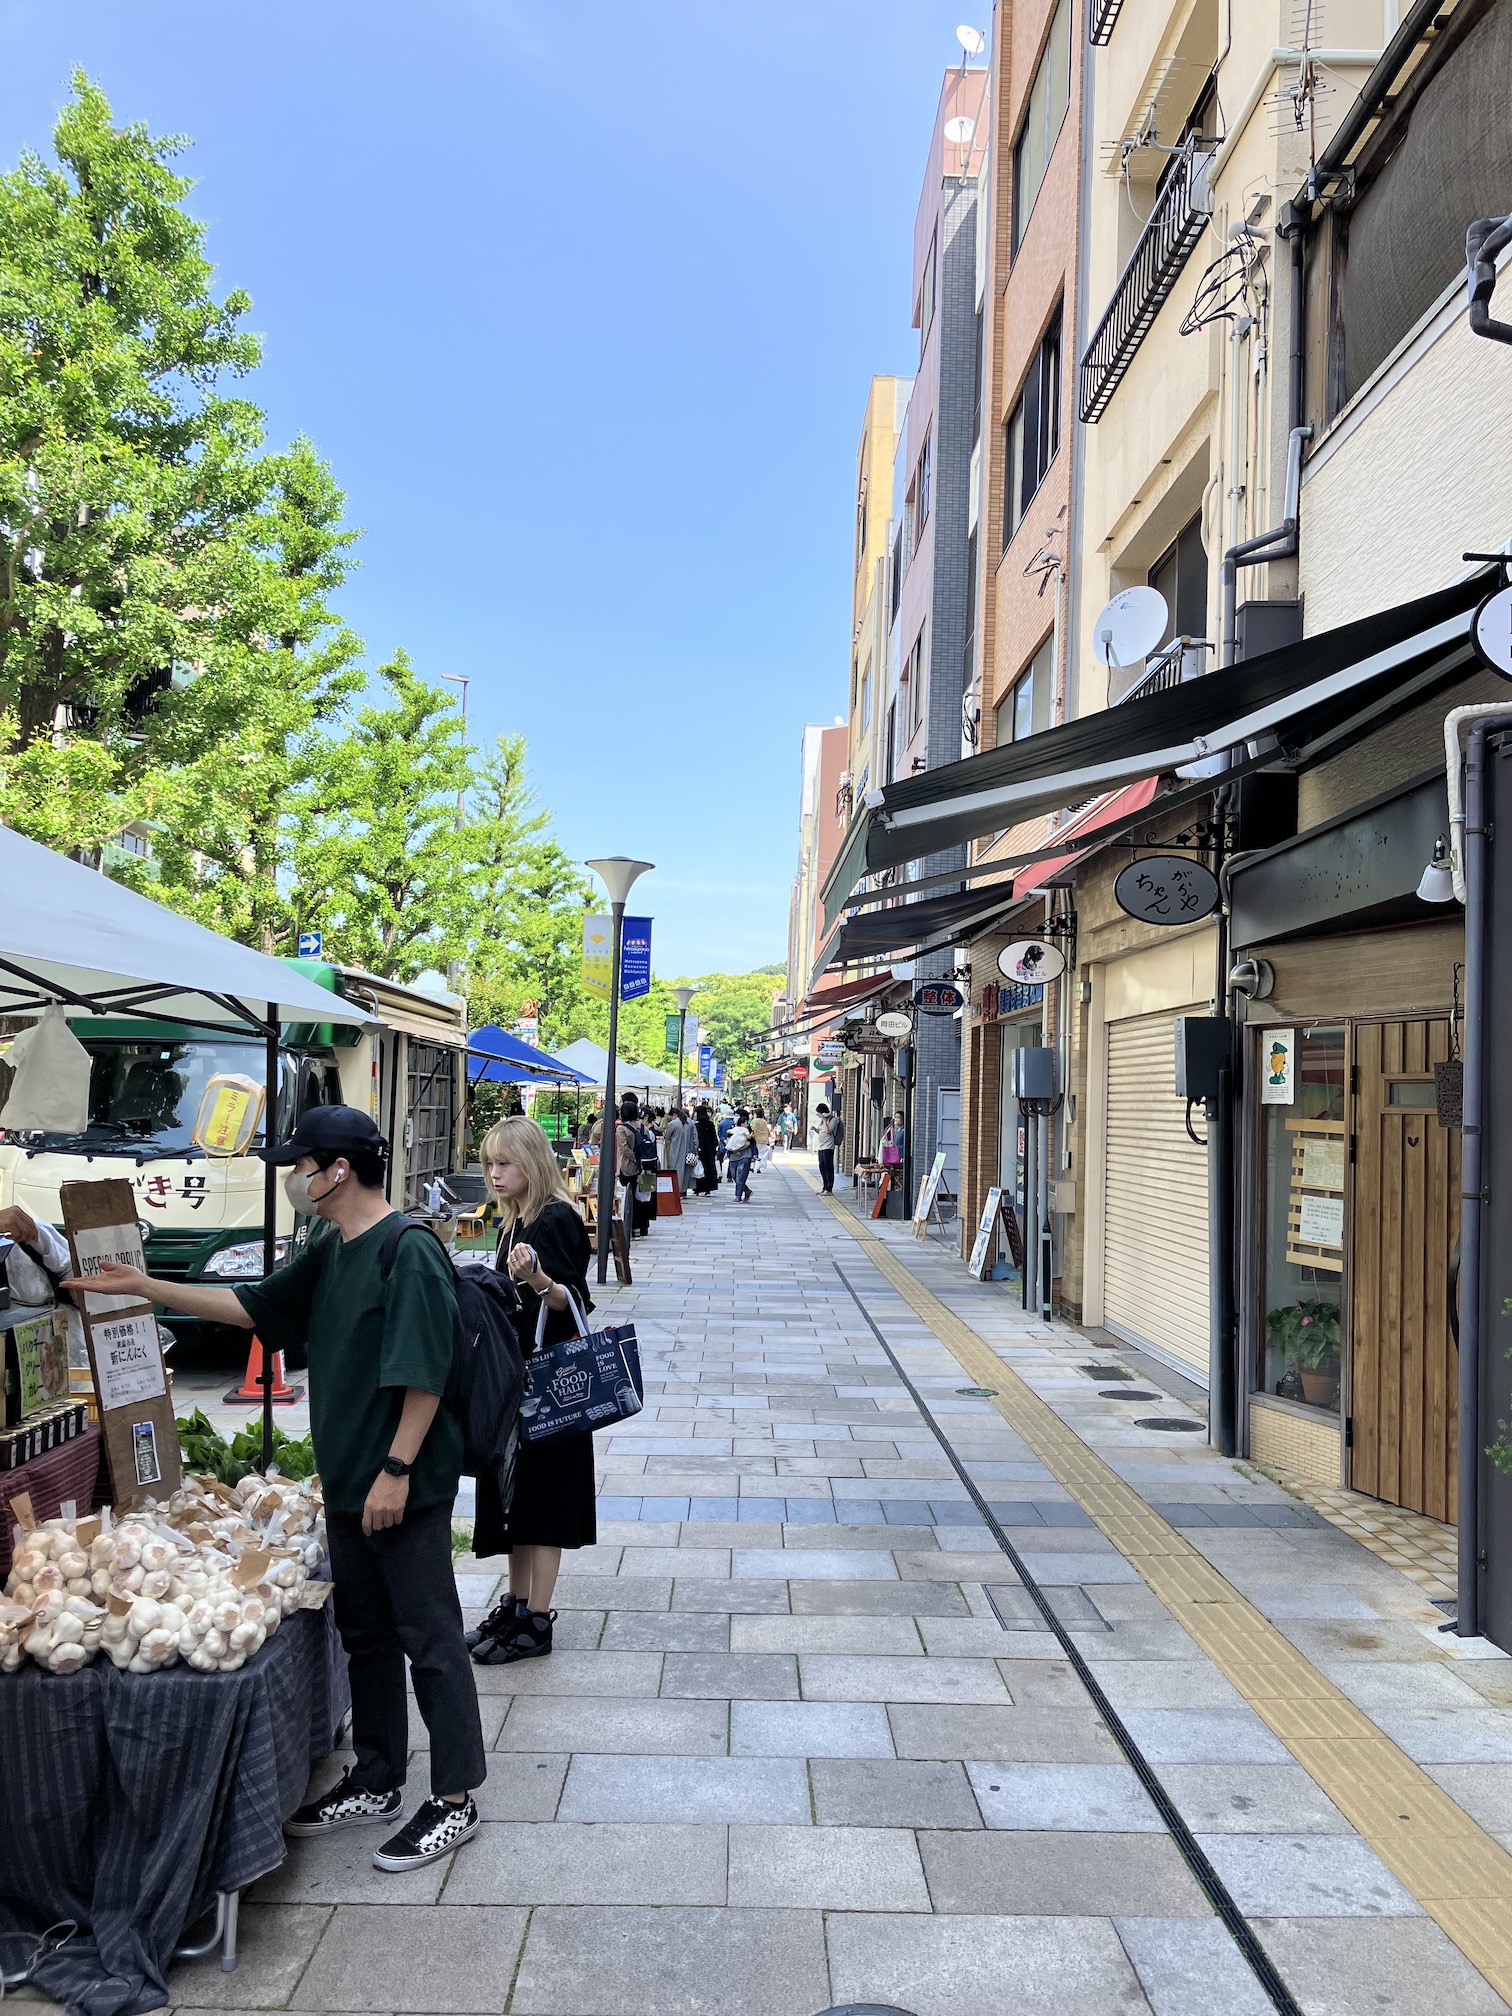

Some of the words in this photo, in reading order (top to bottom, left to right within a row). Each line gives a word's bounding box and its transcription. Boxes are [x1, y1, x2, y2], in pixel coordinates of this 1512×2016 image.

[922, 989, 957, 1006] 整体
[110, 1345, 148, 1366] 新にんにく
[532, 1356, 540, 1364] IS
[540, 1351, 556, 1361] LIFE
[595, 1351, 615, 1362] FOOD
[598, 1363, 618, 1373] LOVE
[551, 1370, 588, 1391] FOOD
[528, 1422, 547, 1434] FOOD
[547, 1419, 555, 1428] IS
[555, 1411, 583, 1426] FUTURE
